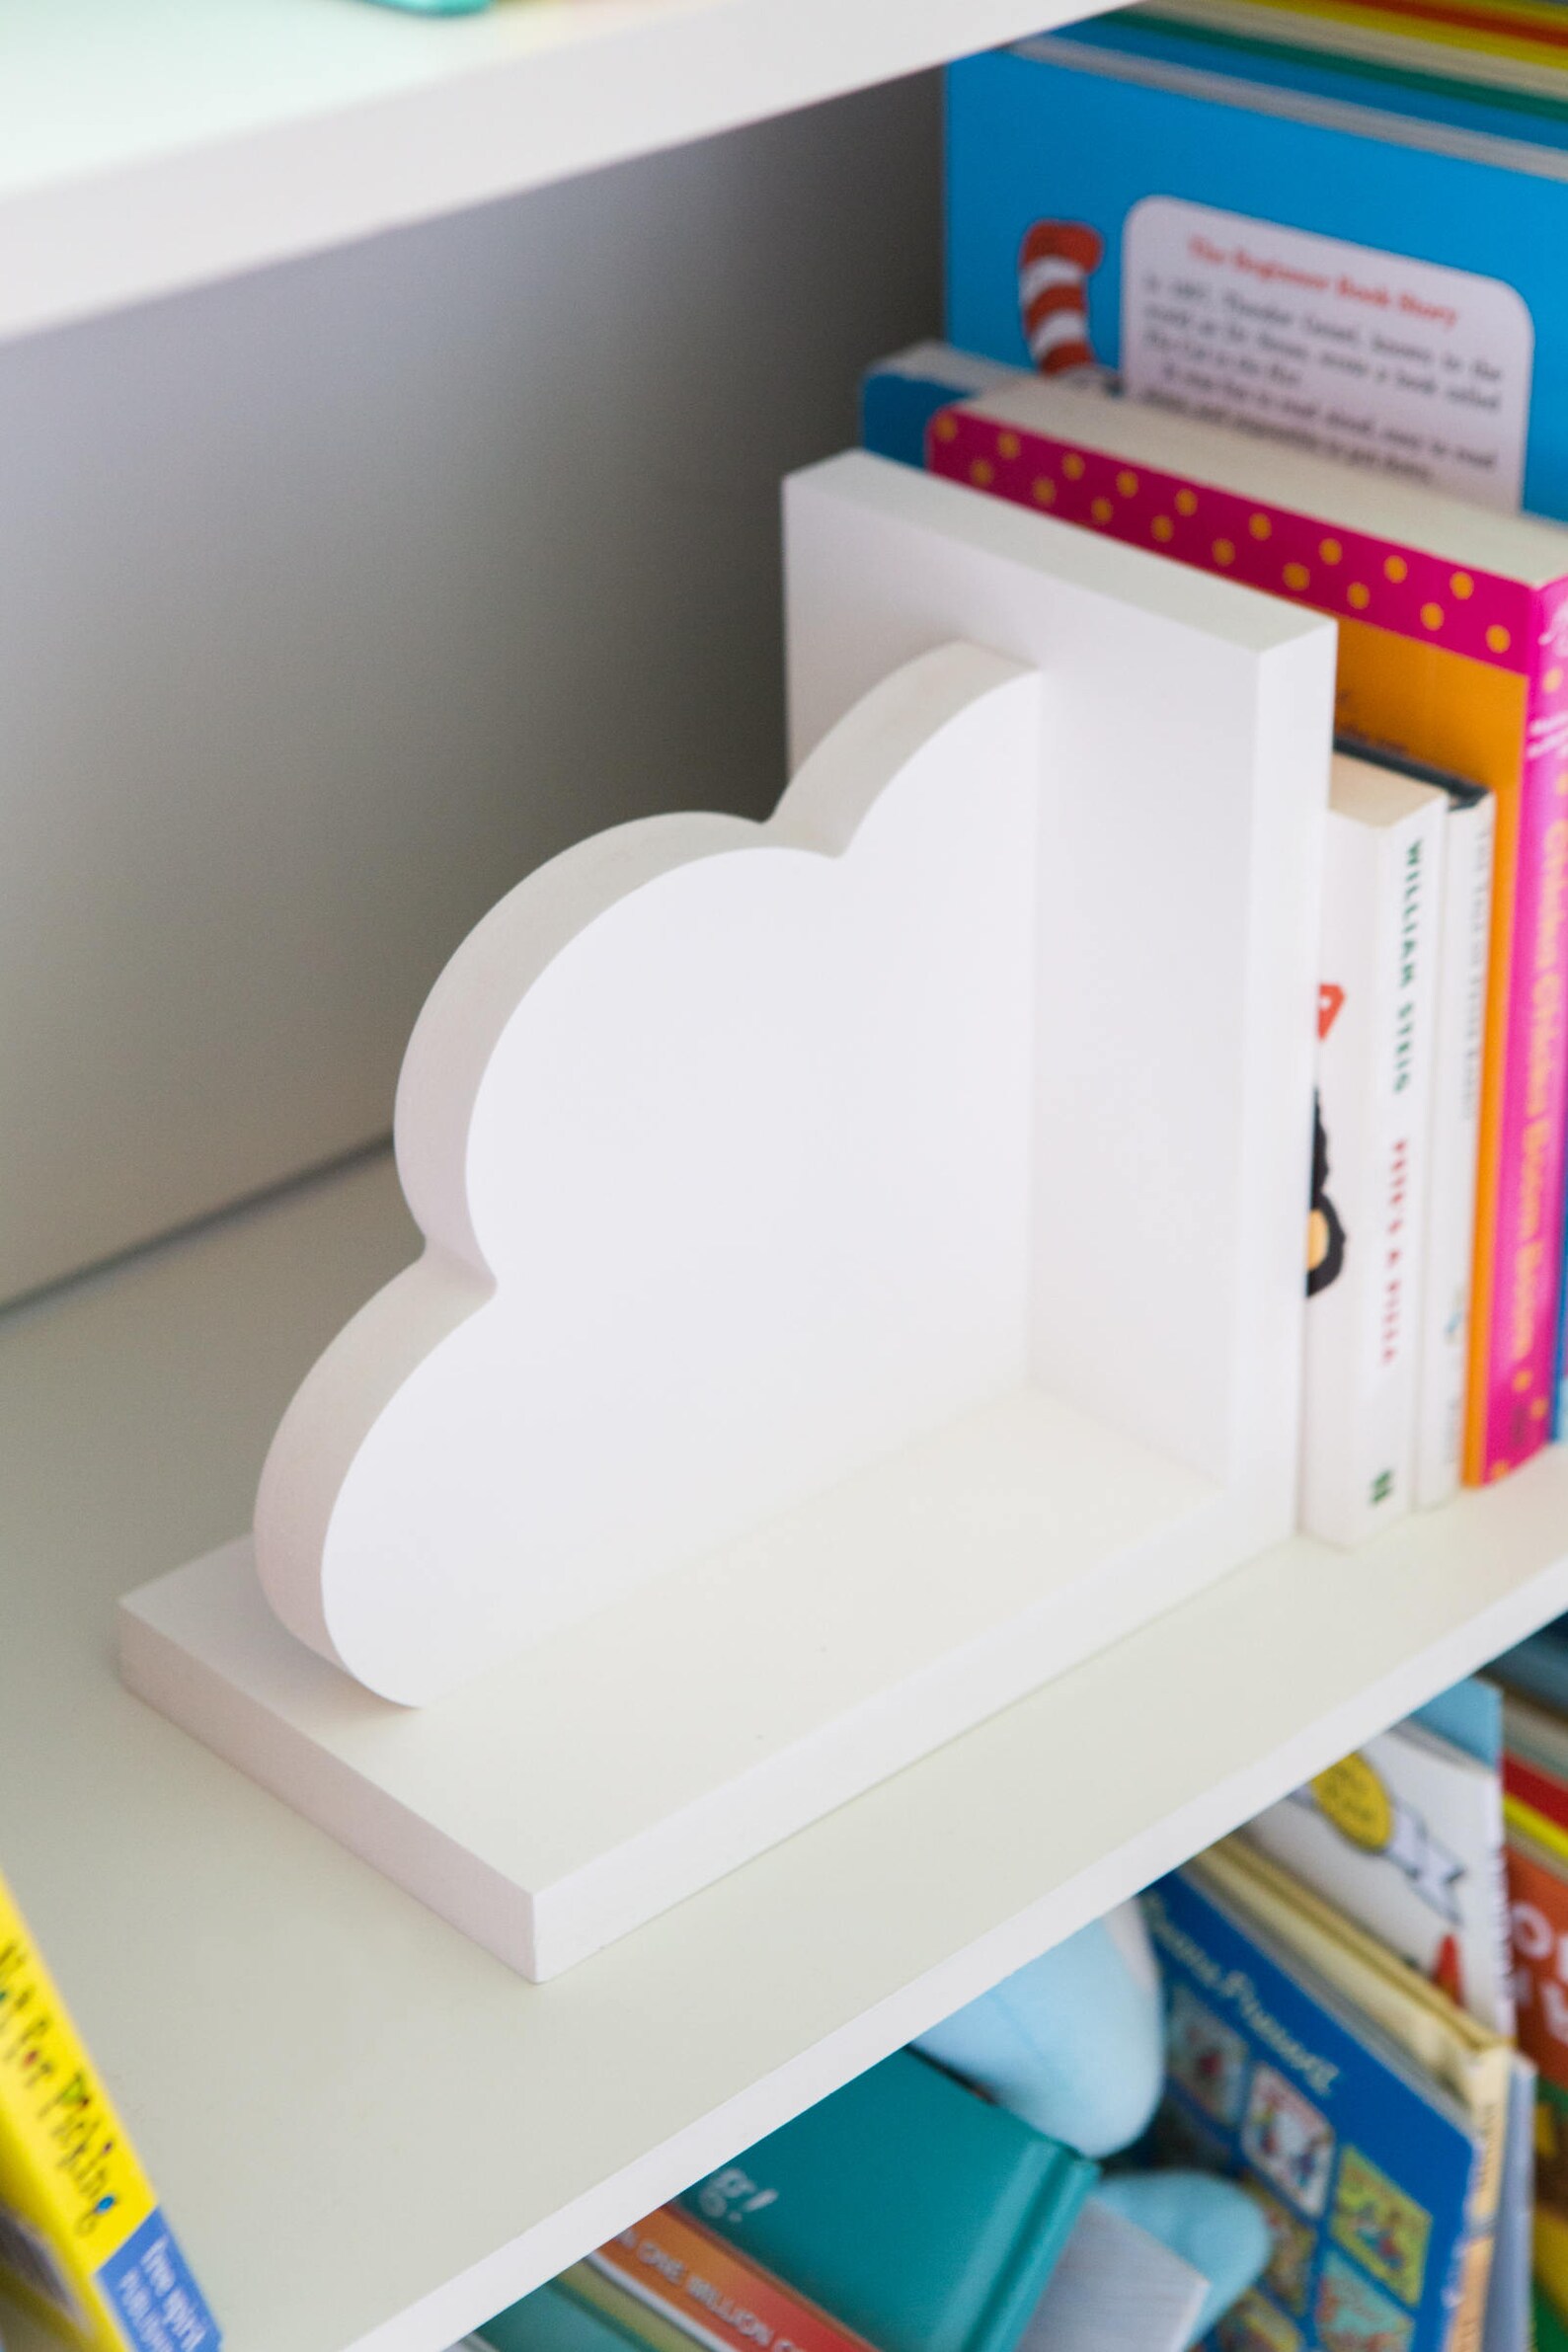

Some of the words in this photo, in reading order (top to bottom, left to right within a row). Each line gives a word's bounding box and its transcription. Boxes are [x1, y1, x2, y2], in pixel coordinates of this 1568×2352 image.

[1189, 237, 1225, 266] The
[1231, 251, 1329, 295] Beginner
[1338, 277, 1390, 308] Book
[1399, 294, 1458, 330] Story
[1400, 838, 1420, 987] WILLIAM
[1393, 1001, 1413, 1093] STEIG
[1381, 1277, 1401, 1368] PIZZA
[38, 2071, 119, 2238] Picking
[141, 2235, 175, 2297] free
[637, 2240, 686, 2286] ONE
[688, 2276, 773, 2345] MILLION
